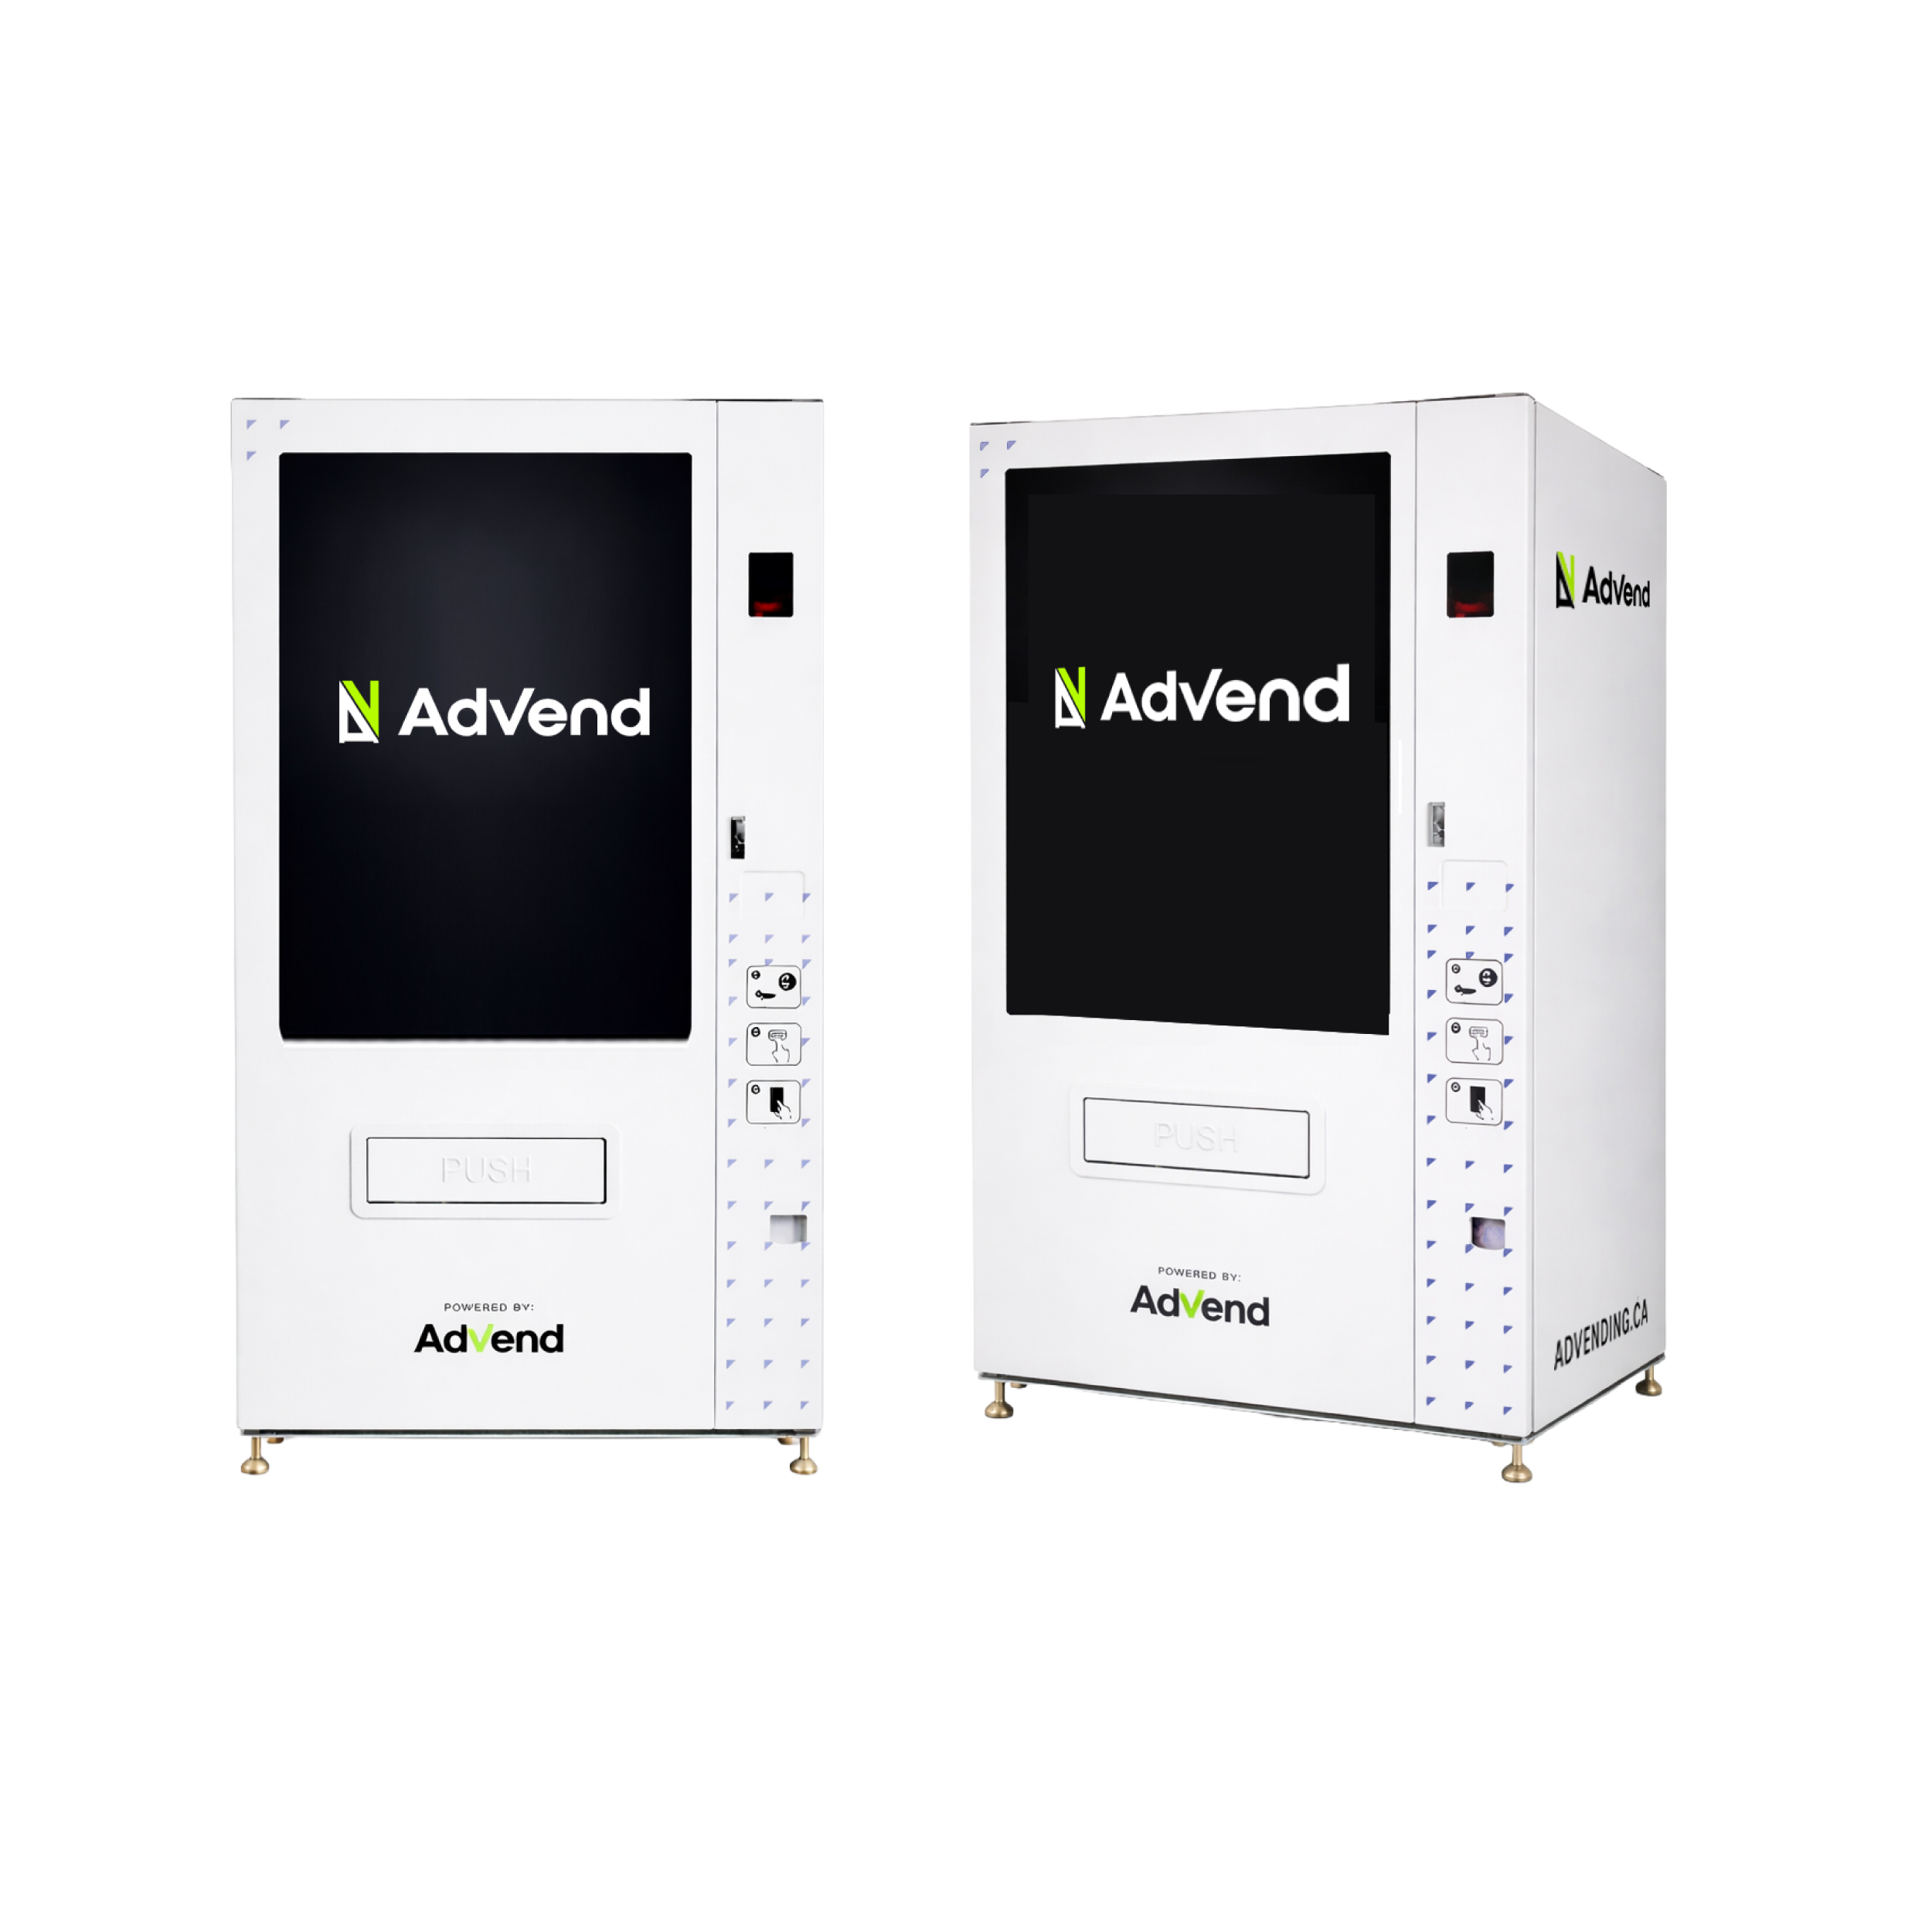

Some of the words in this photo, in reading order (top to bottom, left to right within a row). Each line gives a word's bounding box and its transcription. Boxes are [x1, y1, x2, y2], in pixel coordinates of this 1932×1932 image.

[1154, 1121, 1239, 1153] PUSH
[441, 1155, 532, 1184] PUSH
[1158, 1266, 1217, 1281] POWERED
[1222, 1272, 1242, 1283] BY:
[444, 1303, 508, 1312] POWERED
[513, 1303, 535, 1312] BY:
[1553, 1298, 1648, 1372] ADVENDING.CA
